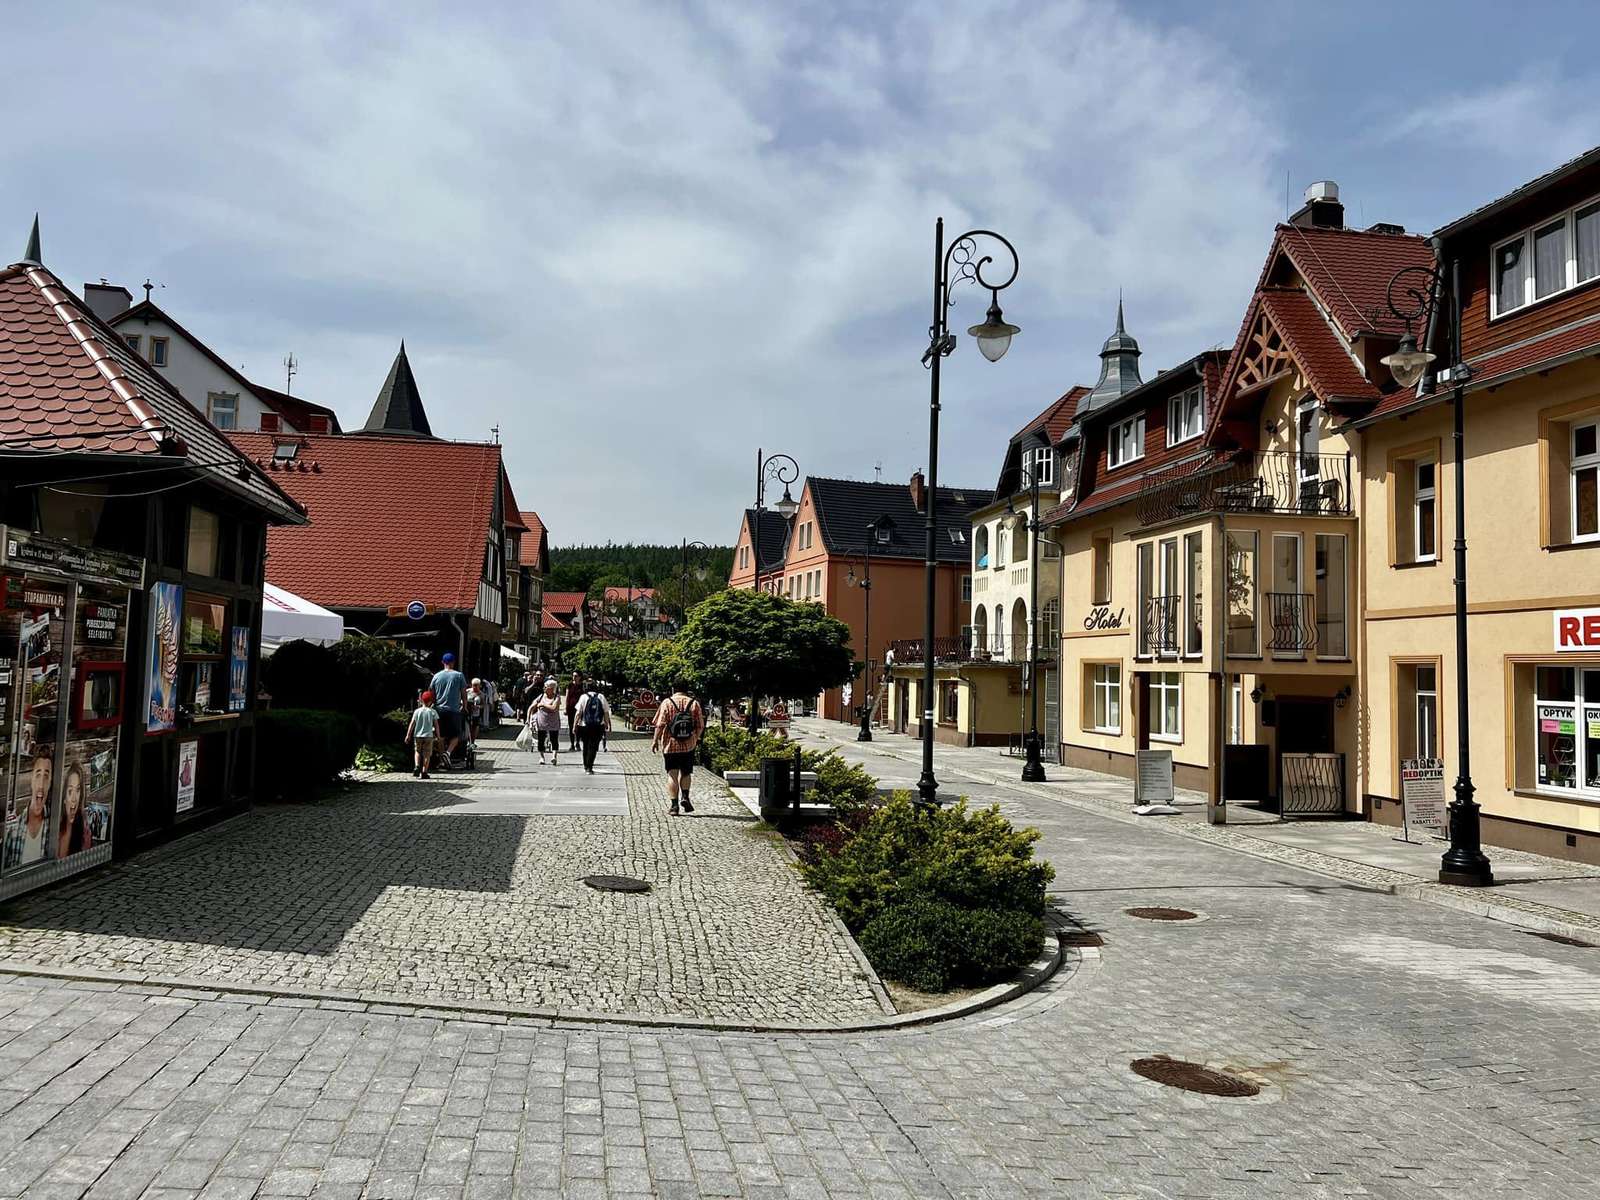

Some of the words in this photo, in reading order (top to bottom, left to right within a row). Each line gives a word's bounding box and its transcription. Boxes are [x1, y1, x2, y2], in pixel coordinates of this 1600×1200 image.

[1083, 607, 1124, 630] Hotel
[1559, 616, 1600, 646] RE
[1543, 708, 1573, 718] OPTYK
[1588, 711, 1600, 719] OK
[1403, 769, 1443, 778] REDOPTIK
